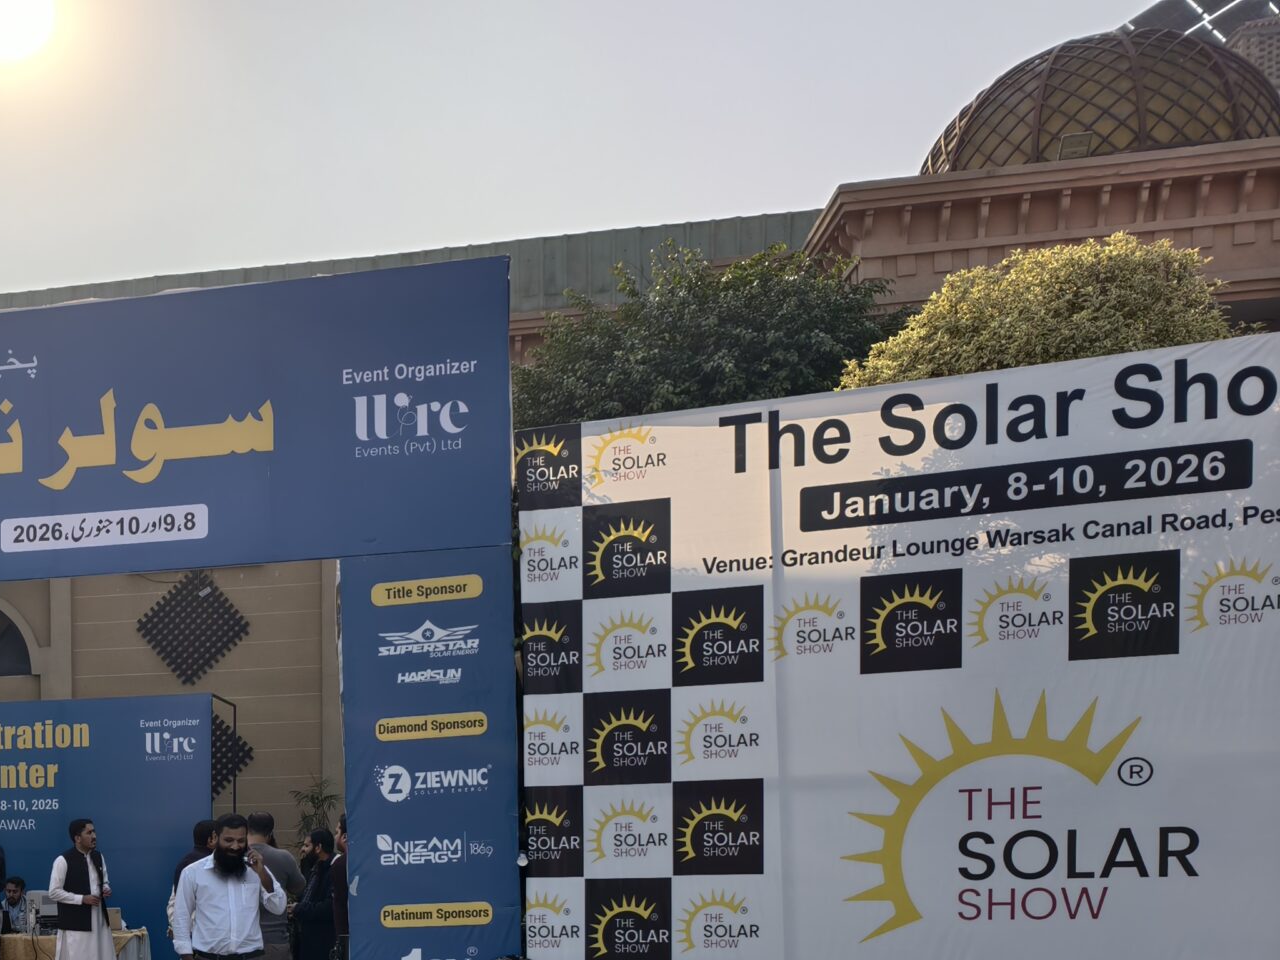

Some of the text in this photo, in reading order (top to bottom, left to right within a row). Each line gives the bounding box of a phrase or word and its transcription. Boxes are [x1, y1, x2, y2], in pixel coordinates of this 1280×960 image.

[342, 359, 477, 384] Event Organizer
[719, 359, 1280, 474] The Solar Sho
[38, 387, 274, 490] سولر
[355, 438, 462, 458] Events (Pvt) Ltd
[526, 456, 545, 467] THE
[526, 465, 578, 482] SOLAR
[526, 481, 560, 492] SHOW
[820, 451, 1226, 521] January, 8-10, 2026
[13, 522, 63, 543] 2026
[116, 516, 140, 536] 10
[702, 556, 774, 574] Venue:
[781, 545, 885, 567] Grandeur
[892, 535, 979, 558] Lounge
[986, 522, 1075, 550] Warsak
[1082, 516, 1153, 540] Canal
[1160, 507, 1234, 533] Road,
[385, 582, 468, 600] Title Sponsor
[895, 609, 918, 621] THE
[895, 618, 958, 637] SOLAR
[378, 638, 480, 656] SUPERSTAR
[895, 636, 935, 648] SHOW
[430, 650, 452, 658] SOLAR
[140, 718, 200, 728] Event Organizer
[379, 717, 484, 735] Diamond Sponsors
[415, 768, 488, 789] ZIEWNIC
[451, 786, 488, 794] ENERGY
[0, 799, 59, 812] 8-10, 2026
[958, 786, 1043, 821] THE
[394, 838, 461, 853] NIZAM
[957, 826, 1200, 881] SOLAR
[957, 886, 1109, 921] SHOW
[383, 908, 489, 922] Platinum Sponsors
